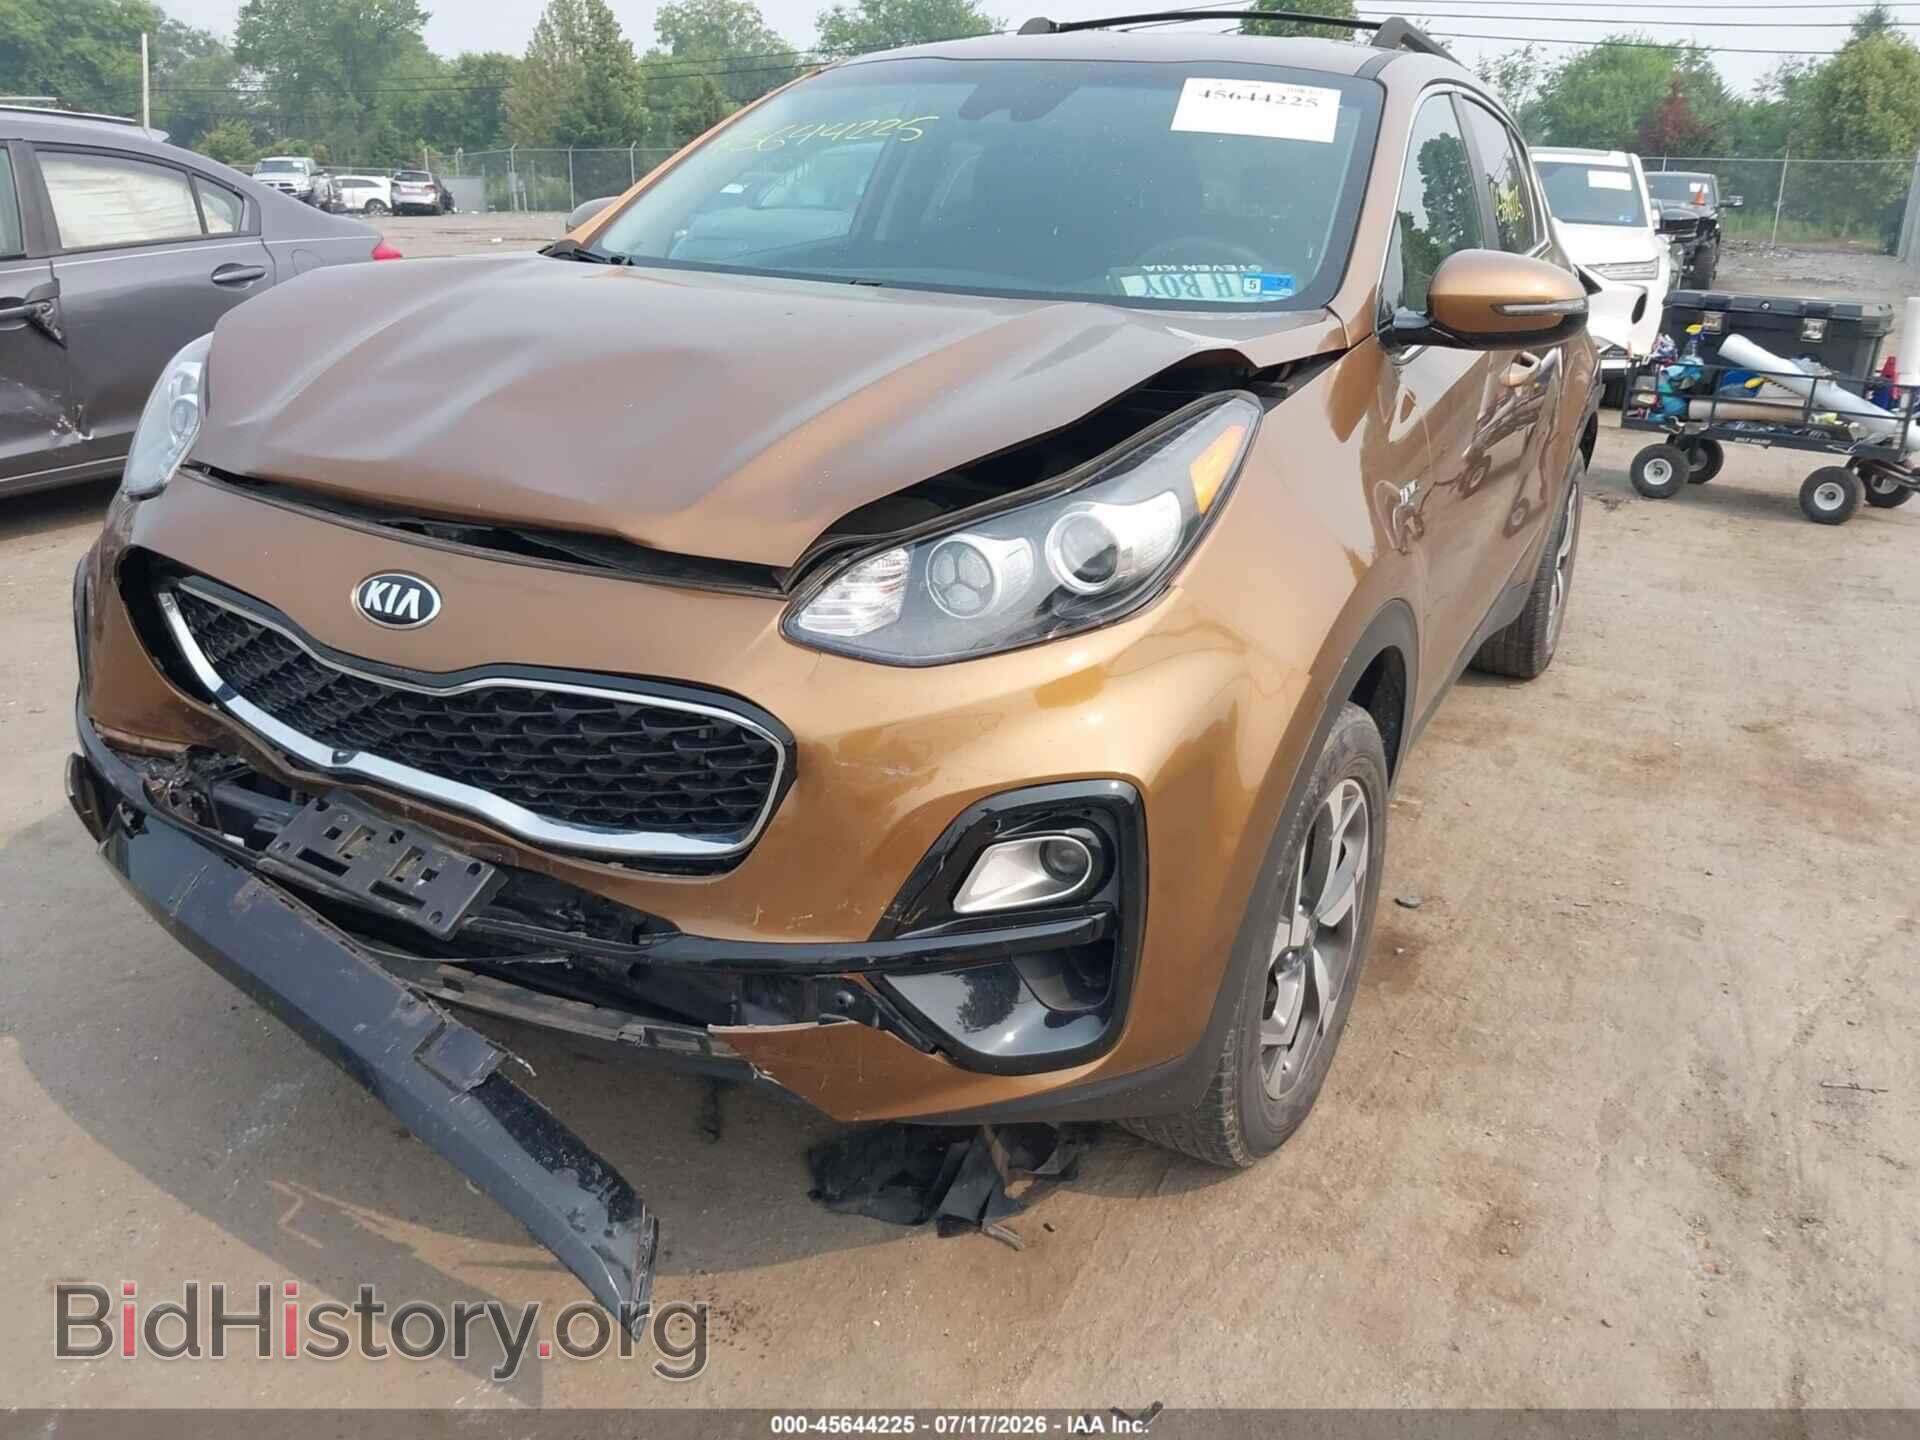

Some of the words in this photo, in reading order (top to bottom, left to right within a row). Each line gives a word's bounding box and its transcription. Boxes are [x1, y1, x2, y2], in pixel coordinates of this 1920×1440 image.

[1198, 89, 1319, 107] 45644225
[1141, 264, 1176, 272] KIA
[1248, 279, 1257, 290] 5
[363, 579, 421, 620] KIA
